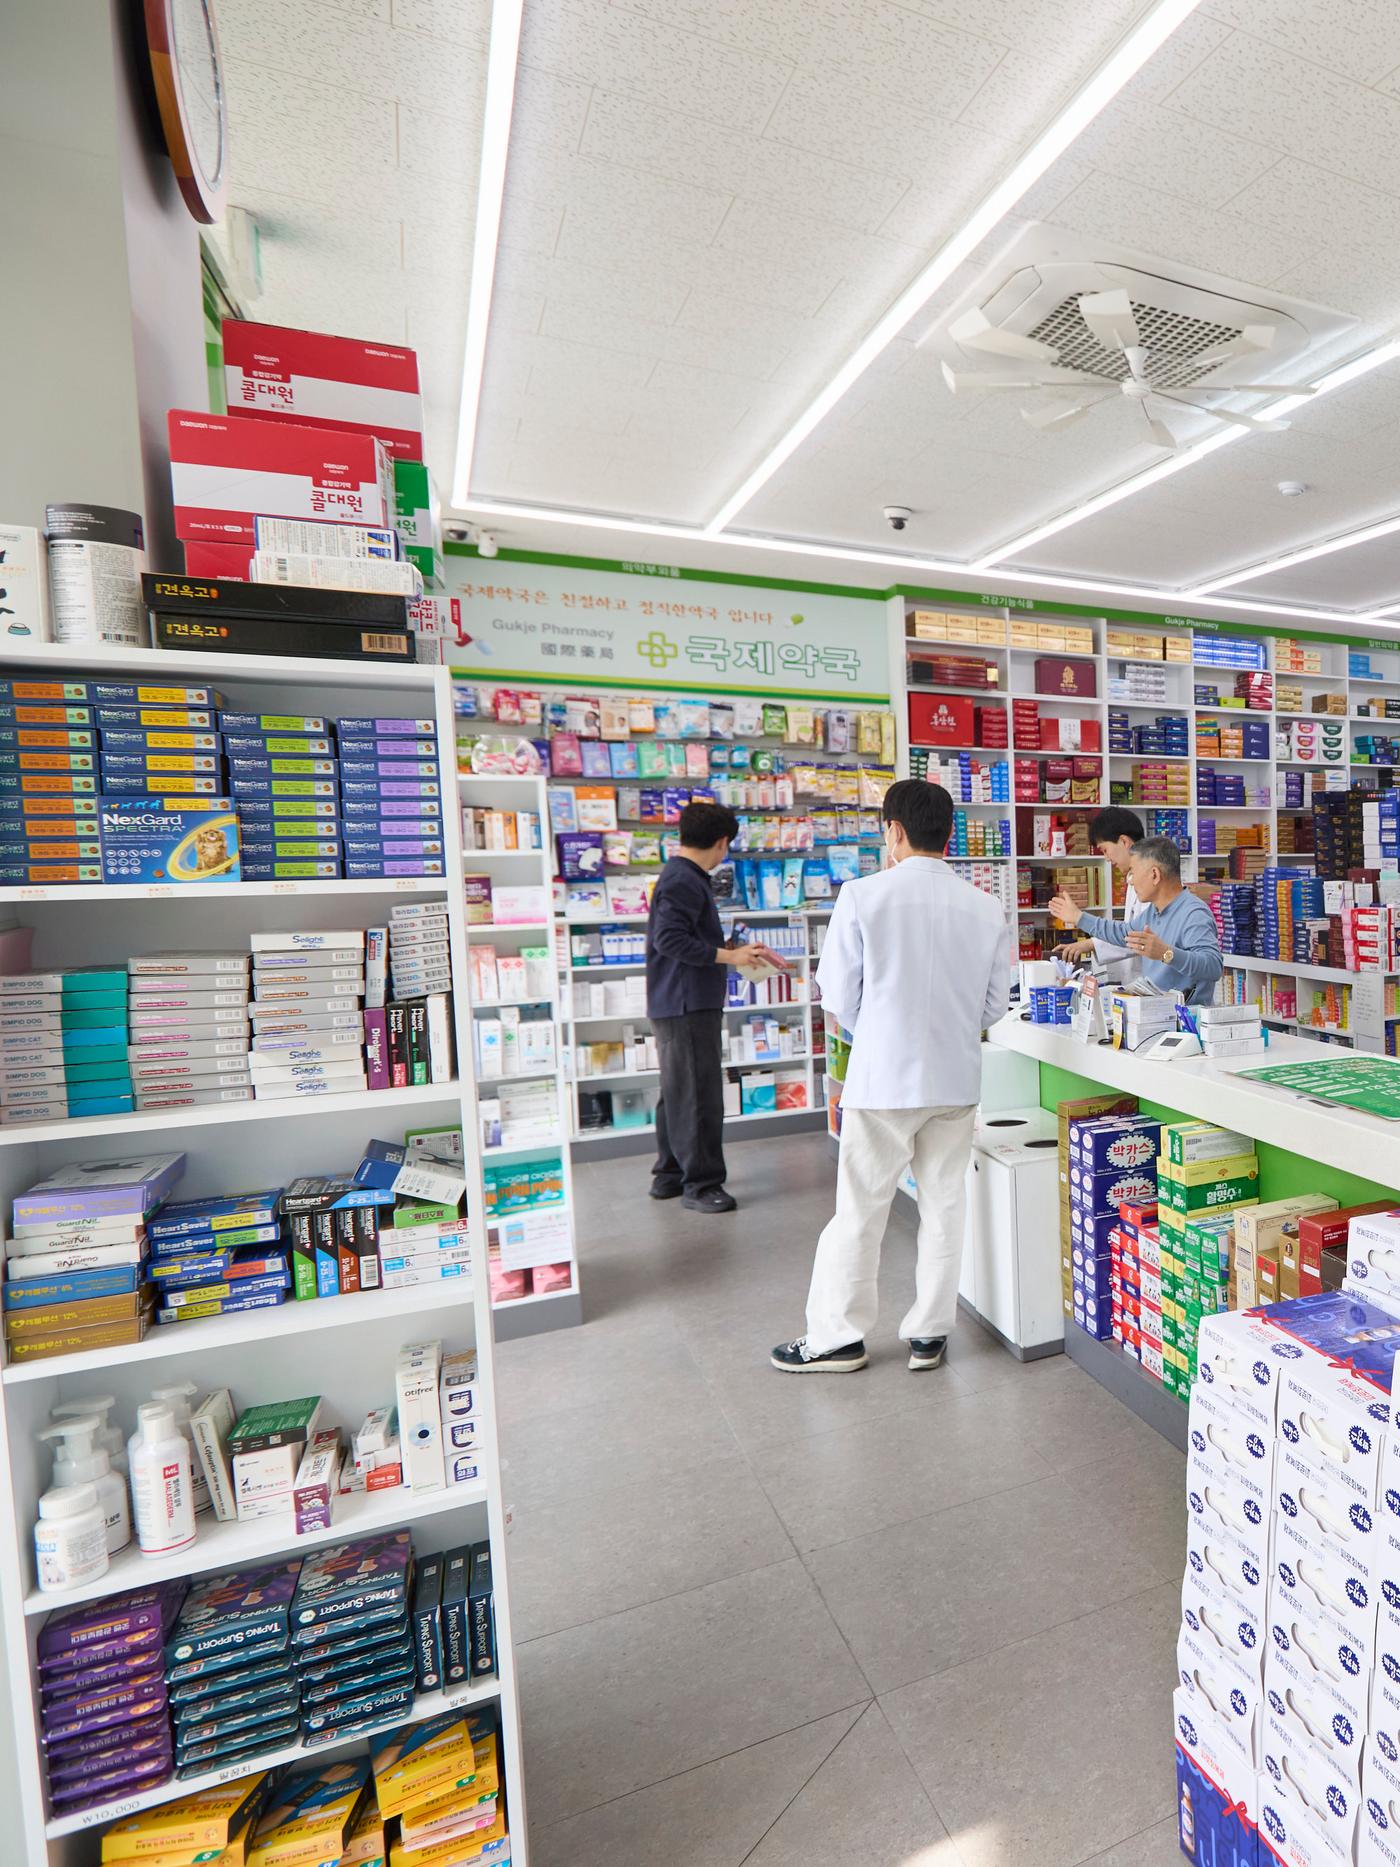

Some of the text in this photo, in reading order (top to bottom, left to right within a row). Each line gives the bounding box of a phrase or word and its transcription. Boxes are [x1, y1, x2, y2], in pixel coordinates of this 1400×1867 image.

[241, 380, 294, 404] 콜대원
[311, 490, 363, 513] 콜대원
[728, 608, 773, 624] 입니다
[492, 618, 614, 641] Gukje Pharmacy
[1191, 617, 1219, 632] Pharmacy
[685, 635, 860, 681] 국제약국
[102, 813, 182, 826] NexGard
[103, 825, 183, 833] SPECTRA
[26, 1017, 42, 1025] DOG
[1112, 1140, 1150, 1156] 박카스
[1128, 1155, 1136, 1164] D
[1112, 1182, 1150, 1198] 박카스
[1206, 1188, 1236, 1205] 활명수
[153, 1220, 210, 1235] HeartSaver
[158, 1236, 214, 1251] HeartSaver
[404, 1385, 434, 1397] Otifree
[319, 1586, 399, 1617] TAPING SUPPORT
[196, 1621, 282, 1651] TAPING SUPPORT
[449, 1629, 461, 1665] SUPPORT
[422, 1637, 434, 1674] SUPPORT
